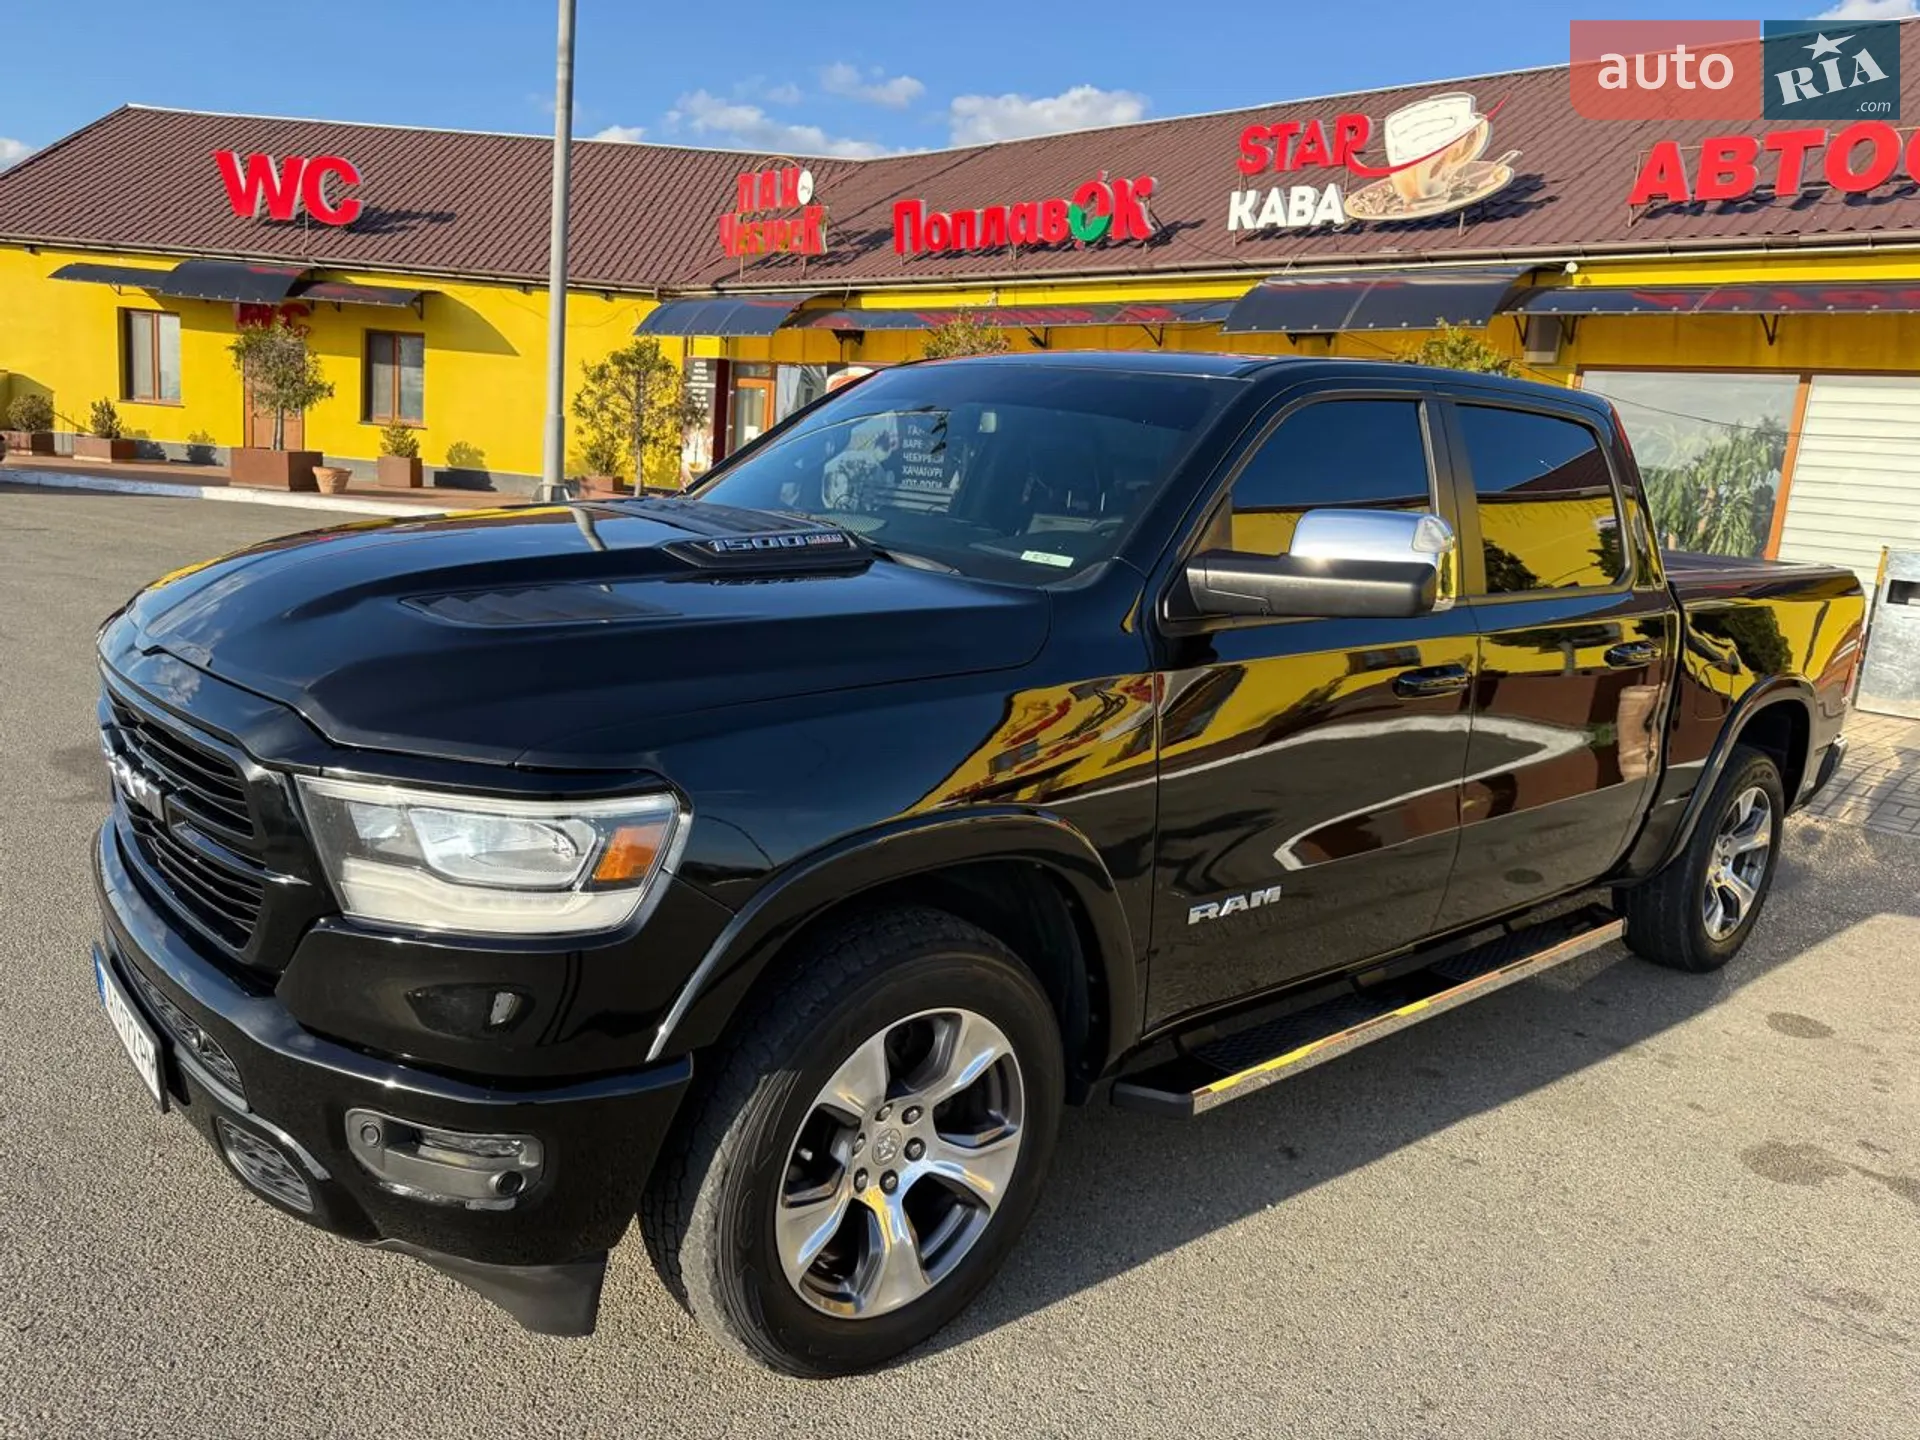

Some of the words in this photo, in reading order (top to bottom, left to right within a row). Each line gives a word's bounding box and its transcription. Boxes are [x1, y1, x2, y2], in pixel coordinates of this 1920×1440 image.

[1237, 112, 1371, 178] STAR
[1627, 120, 1920, 205] АВТО
[213, 149, 363, 226] WC
[737, 167, 800, 213] ПАН
[893, 173, 1158, 255] ПоплавОК
[1227, 183, 1346, 232] КАВА
[708, 535, 806, 551] 1500
[1188, 886, 1281, 925] RAM
